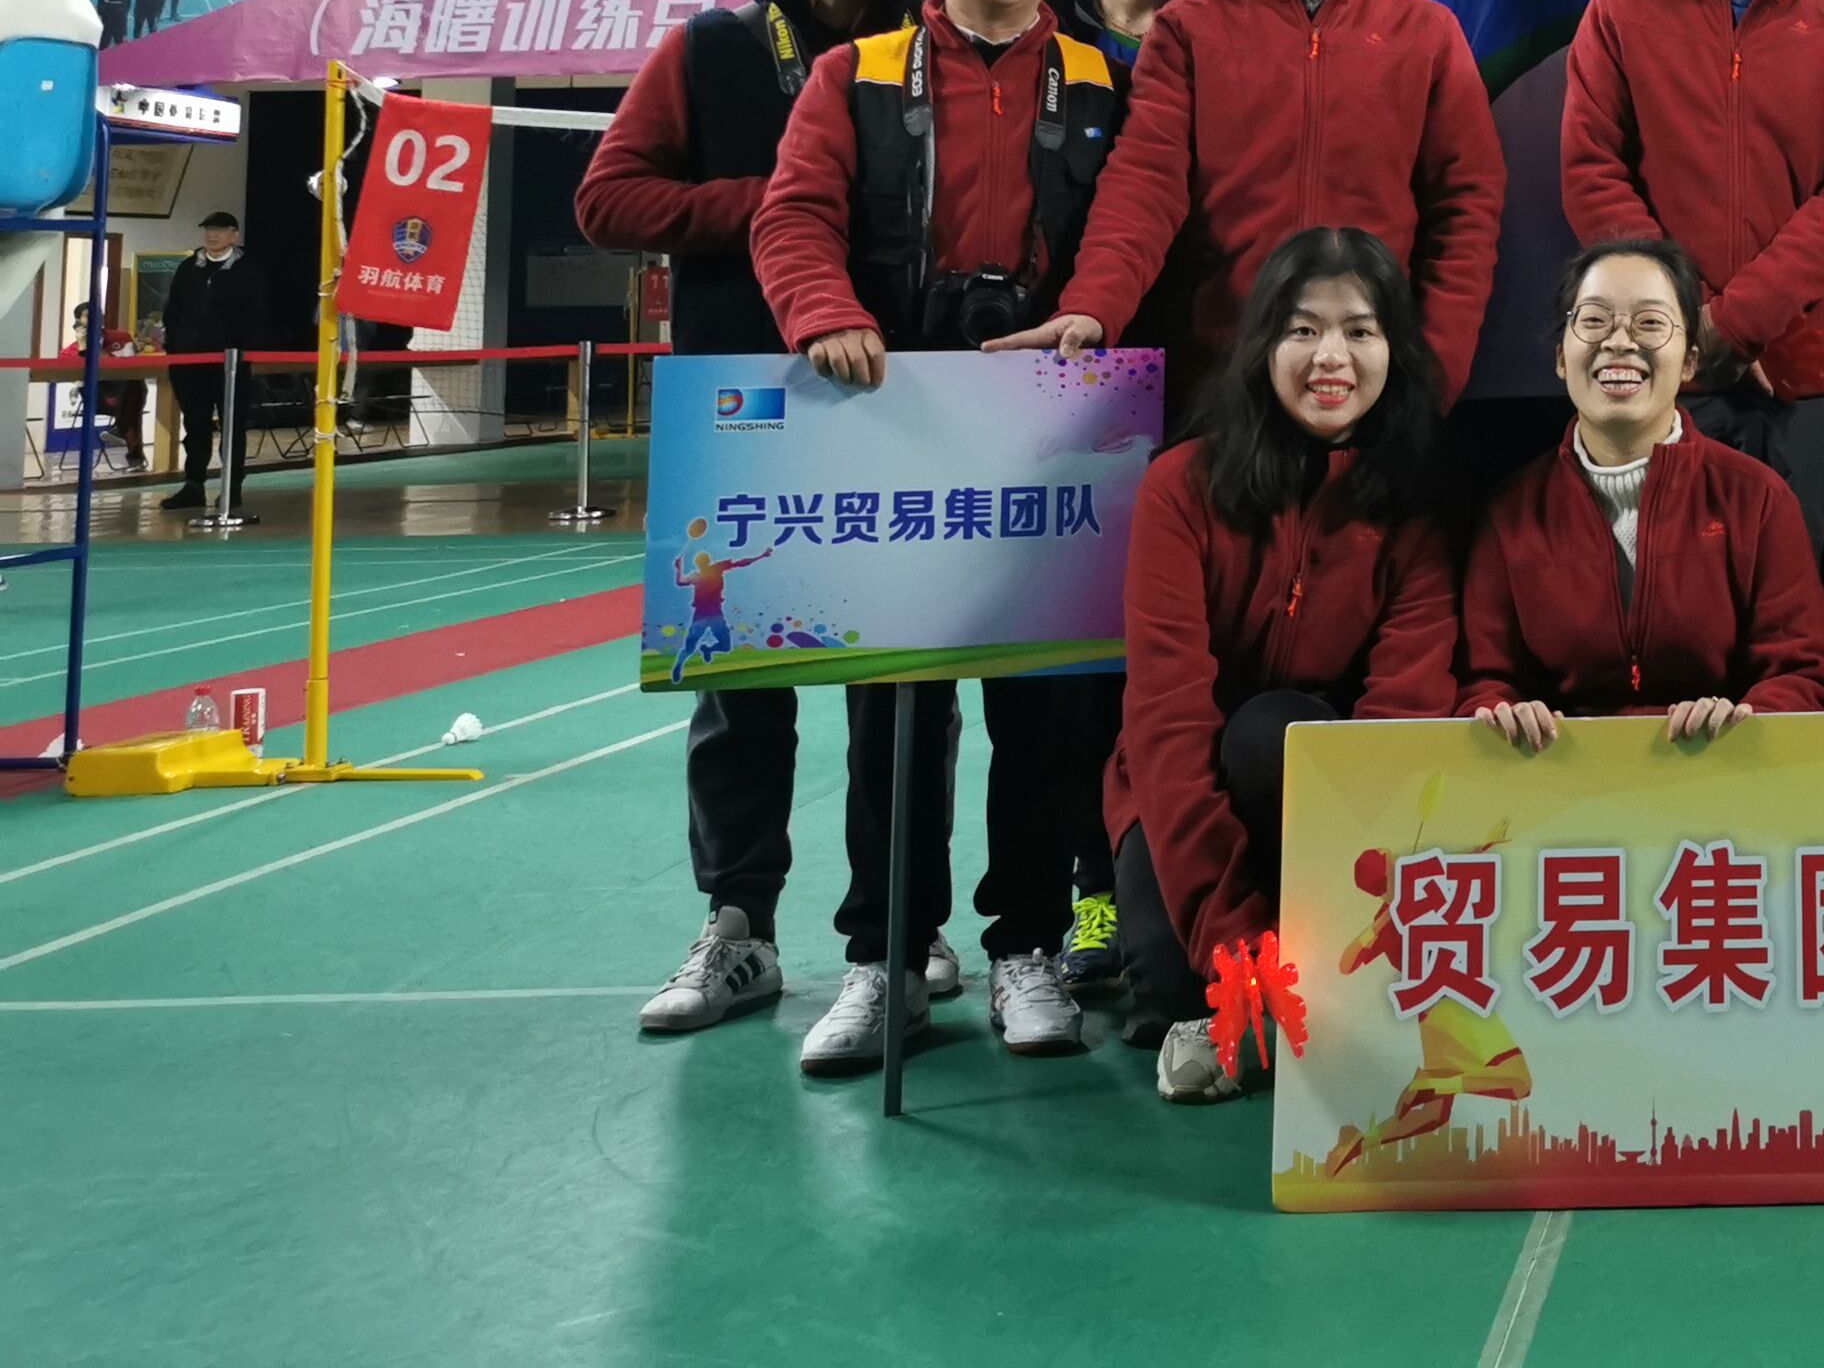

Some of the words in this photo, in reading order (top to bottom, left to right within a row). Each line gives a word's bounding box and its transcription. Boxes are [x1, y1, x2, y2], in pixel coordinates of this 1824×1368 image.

[775, 19, 795, 60] Nikon
[912, 70, 923, 98] EOS
[1046, 68, 1060, 113] Canon
[385, 129, 471, 193] 02
[358, 265, 446, 305] 羽航体育
[715, 422, 785, 432] NINGSHING
[716, 483, 1102, 548] 宁兴贸易集团队
